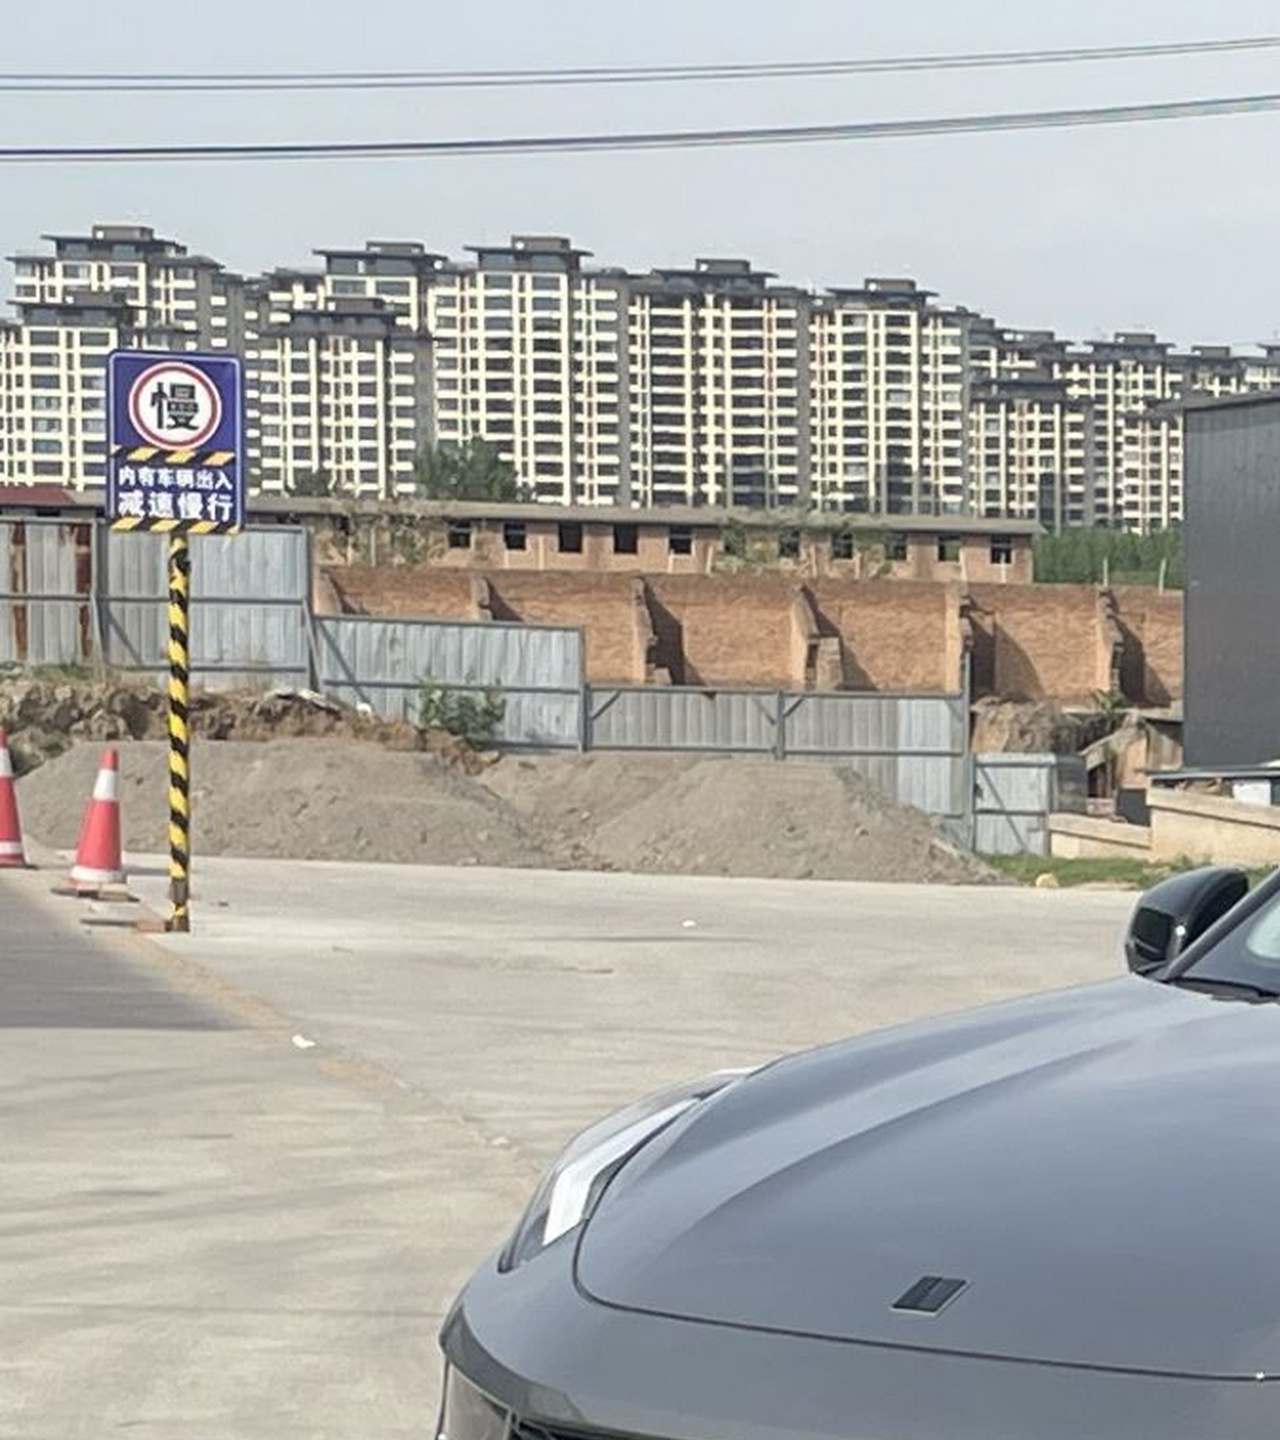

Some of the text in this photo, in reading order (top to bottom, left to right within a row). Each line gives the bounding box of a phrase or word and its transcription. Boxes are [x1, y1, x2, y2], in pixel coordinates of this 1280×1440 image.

[150, 382, 200, 430] 慢
[118, 465, 233, 490] 内有车辆出入
[117, 490, 233, 522] 减速慢行
